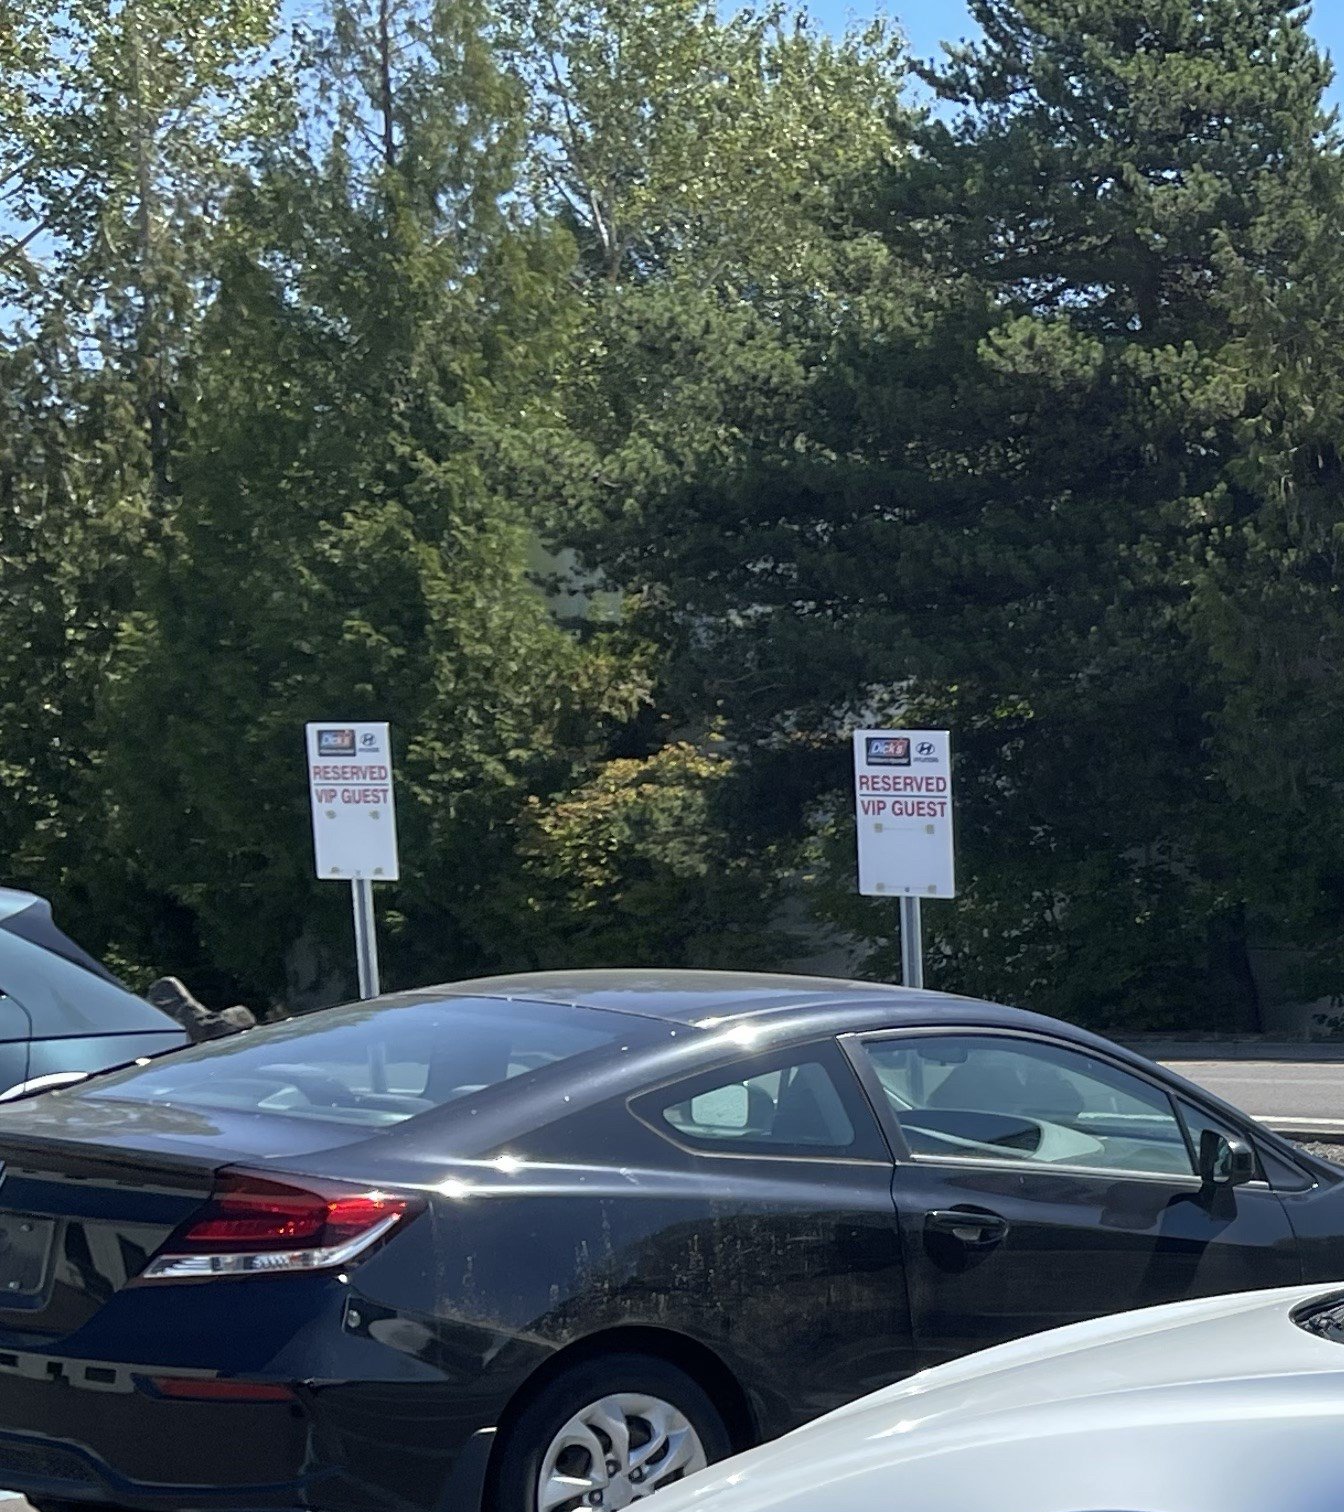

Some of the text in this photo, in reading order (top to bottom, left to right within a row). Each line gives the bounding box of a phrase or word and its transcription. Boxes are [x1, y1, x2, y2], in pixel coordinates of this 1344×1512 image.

[313, 765, 388, 781] RESERVED
[859, 775, 947, 792] RESERVED
[315, 788, 389, 804] VIP GUEST
[861, 800, 947, 817] VIP GUEST
